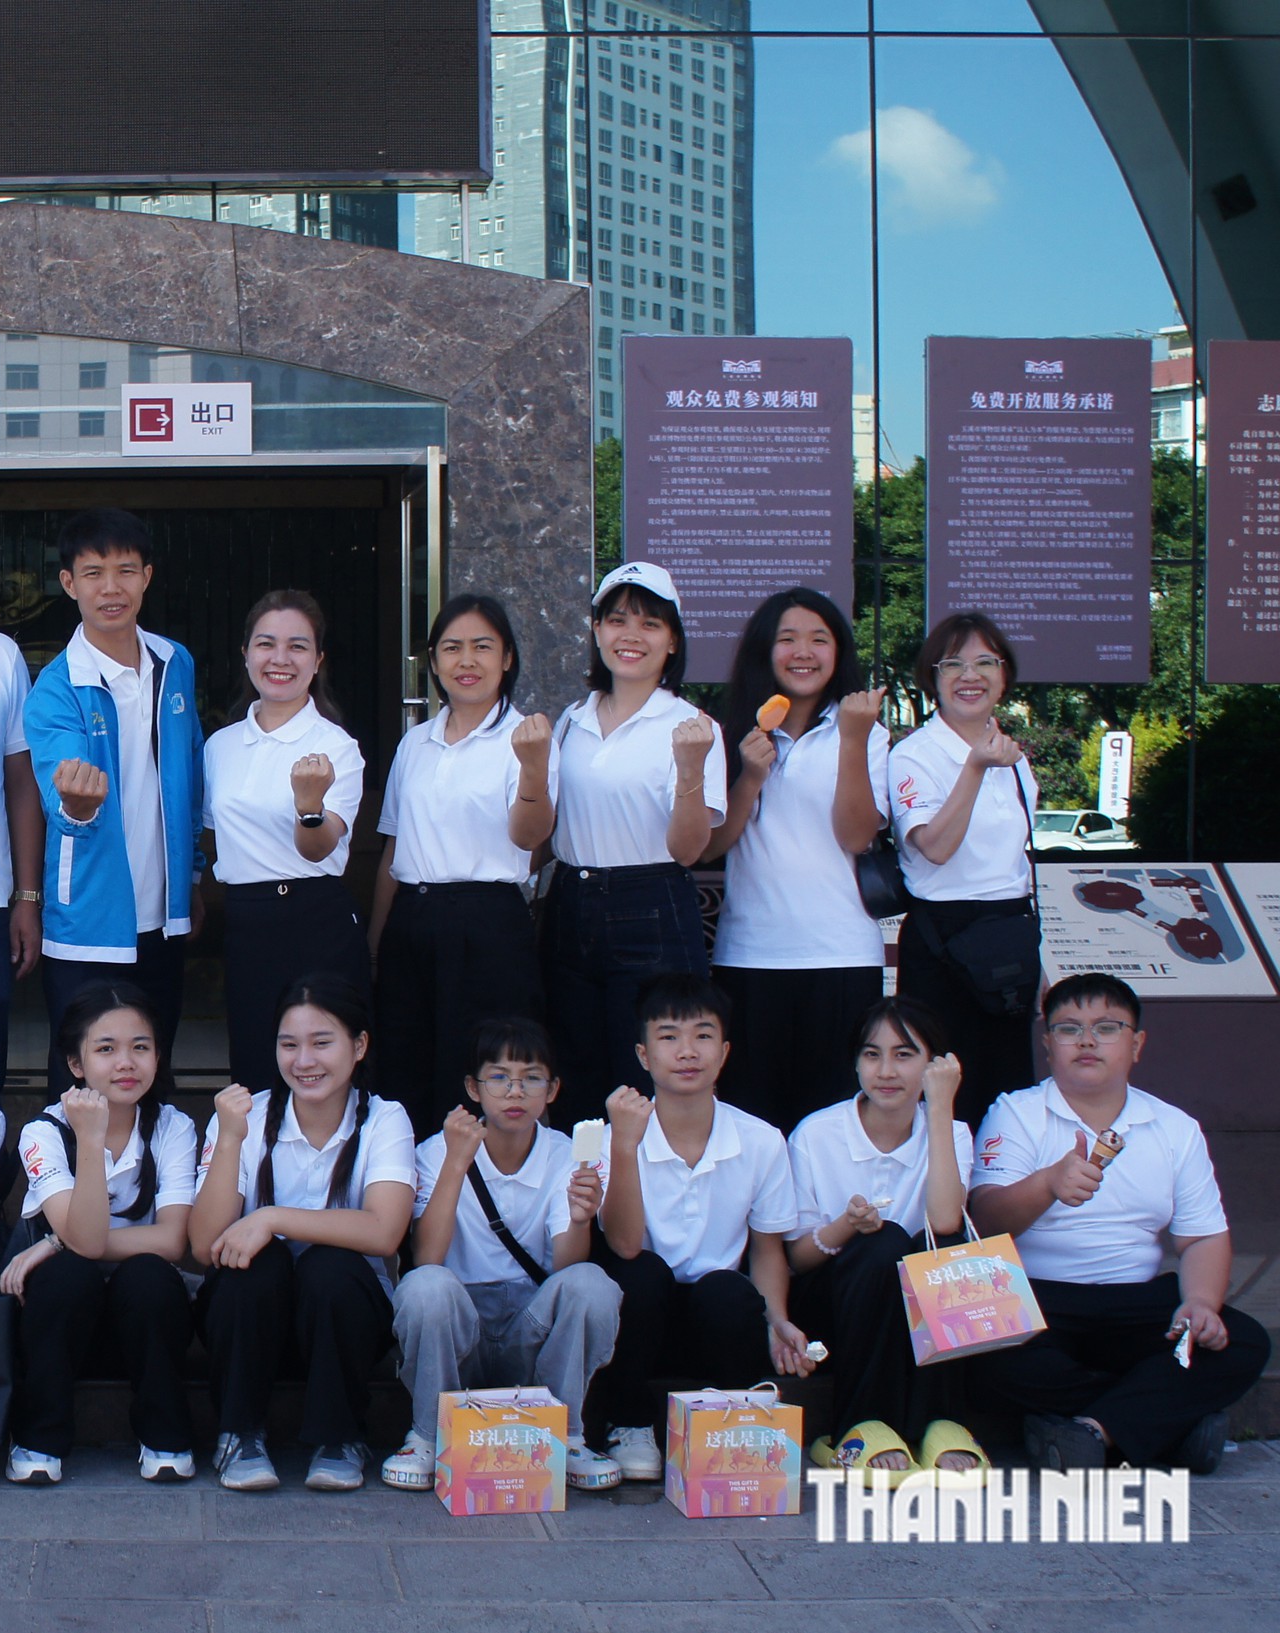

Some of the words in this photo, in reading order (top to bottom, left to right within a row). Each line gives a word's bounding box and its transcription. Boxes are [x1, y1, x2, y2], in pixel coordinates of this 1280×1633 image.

[665, 389, 818, 409] 观众免费参观须知
[970, 391, 1114, 411] 免费开放服务承诺
[1257, 394, 1280, 412] 志
[191, 402, 234, 424] 出口
[201, 427, 224, 435] EXIT
[1146, 963, 1173, 975] 1F
[924, 1255, 1007, 1286] 这礼是玉溪
[468, 1427, 552, 1447] 这礼是玉溪
[705, 1428, 787, 1448] 这礼是玉溪
